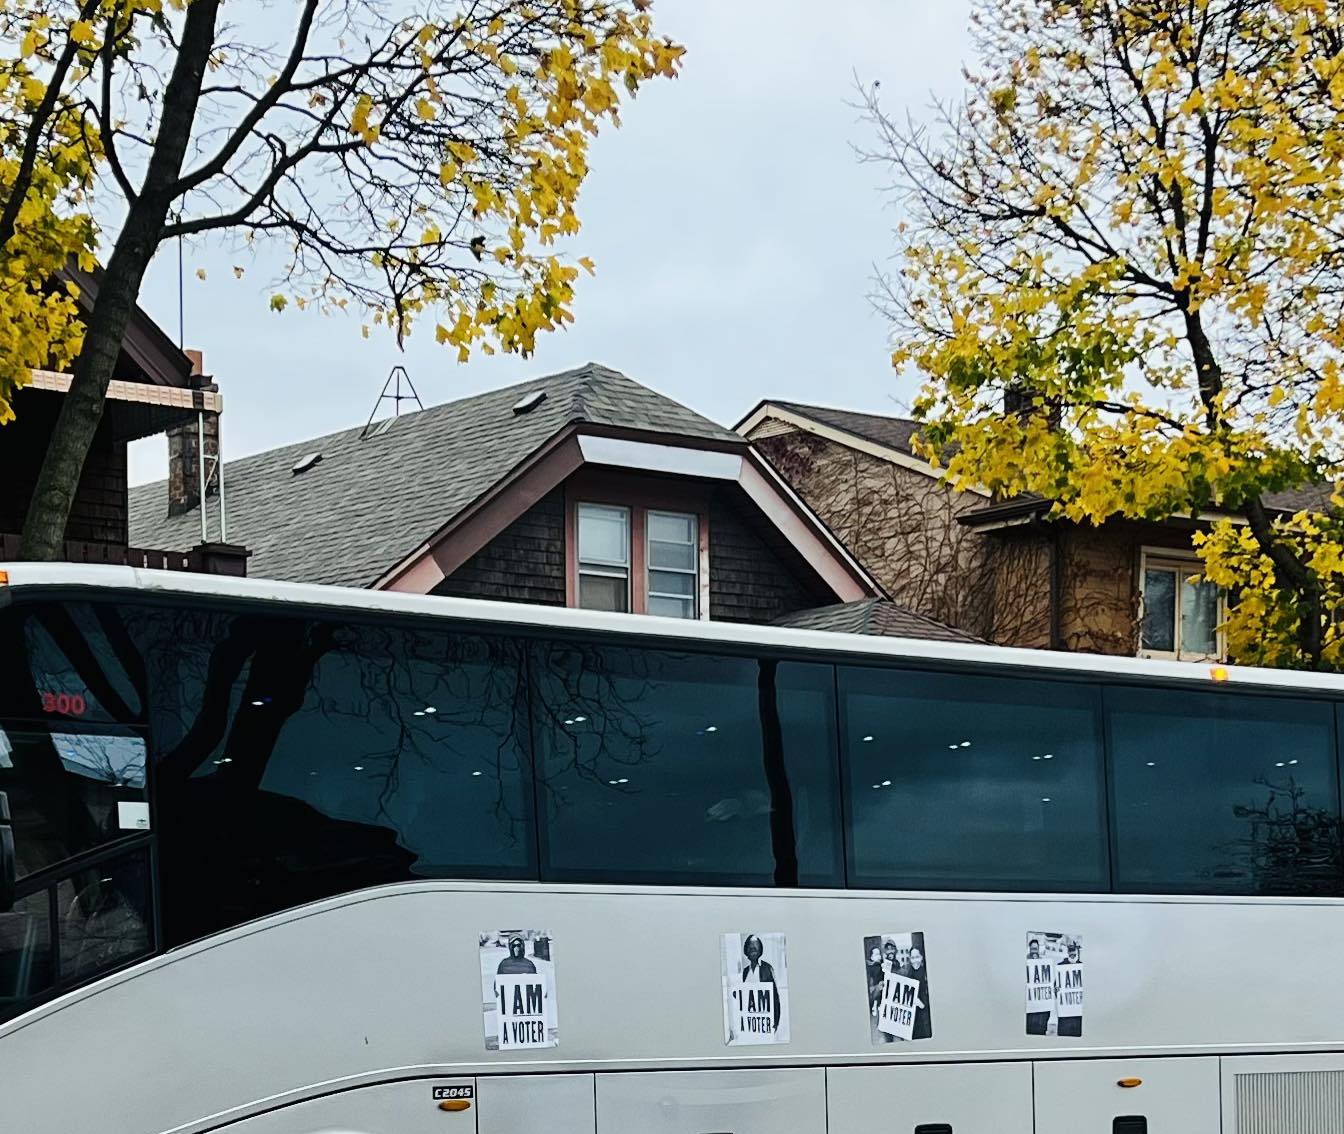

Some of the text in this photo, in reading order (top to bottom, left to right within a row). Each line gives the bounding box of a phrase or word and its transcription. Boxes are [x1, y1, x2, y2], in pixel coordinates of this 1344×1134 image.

[1026, 964, 1051, 984] I AM
[1058, 969, 1083, 989] I AM
[500, 983, 543, 1015] I AM
[739, 989, 771, 1013] I AM
[885, 979, 916, 1008] I AM
[1034, 986, 1052, 1001] VOTER
[1065, 991, 1083, 1005] VOTER
[740, 1016, 771, 1033] A VOTER
[882, 1003, 912, 1026] A VOTER
[503, 1020, 544, 1044] A VOTER
[434, 1087, 472, 1098] C2045
